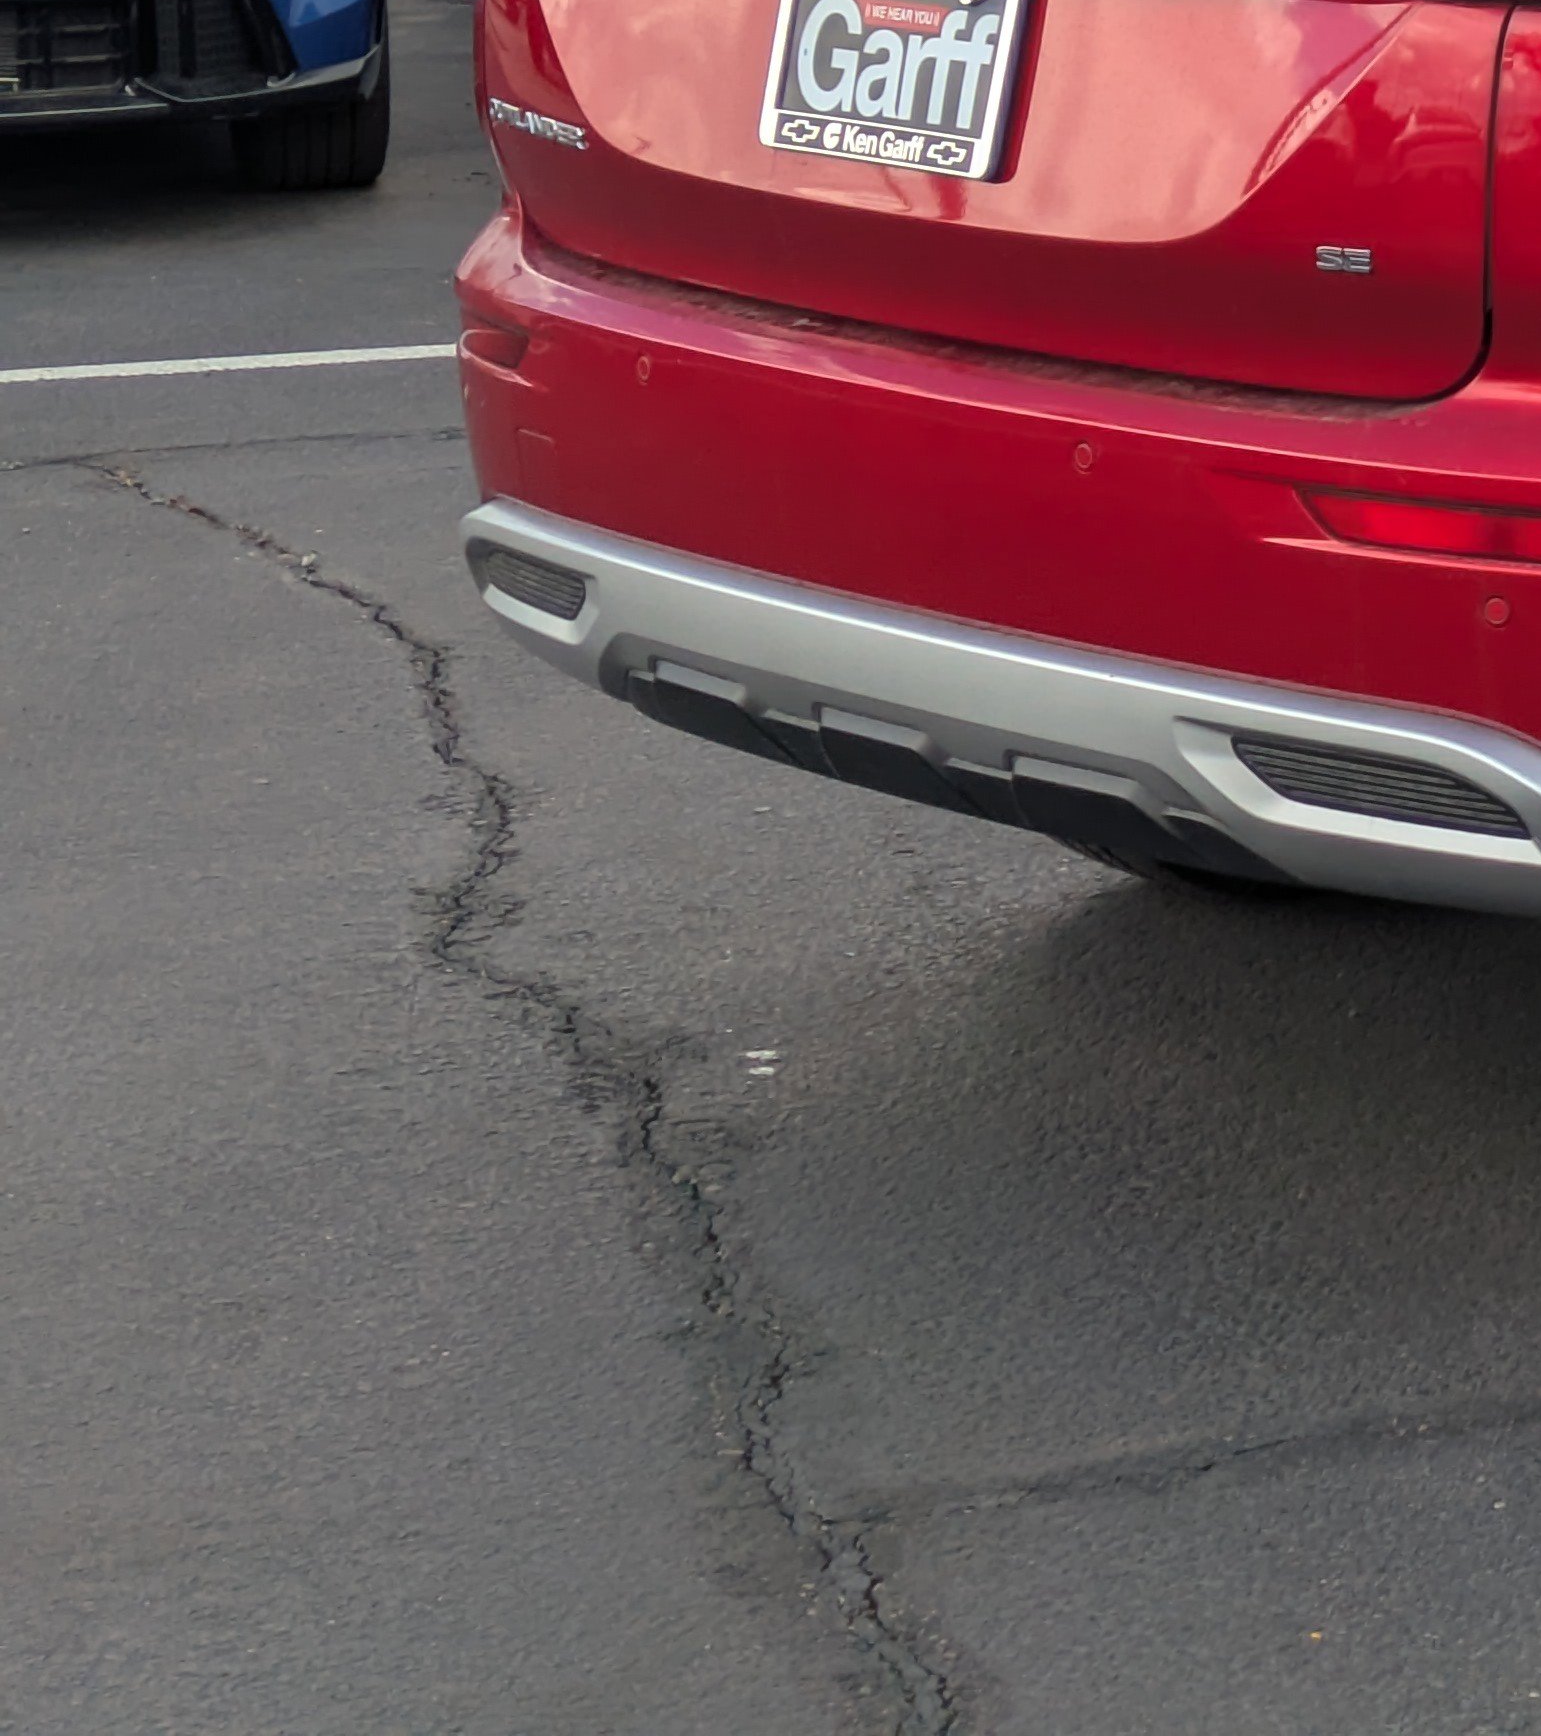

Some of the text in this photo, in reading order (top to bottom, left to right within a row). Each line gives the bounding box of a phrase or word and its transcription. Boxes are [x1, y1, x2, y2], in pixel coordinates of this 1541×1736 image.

[887, 7, 914, 24] HEAR
[914, 11, 934, 25] YOU
[842, 124, 878, 155] Ken
[878, 131, 925, 163] Garff
[1315, 245, 1371, 274] SE
